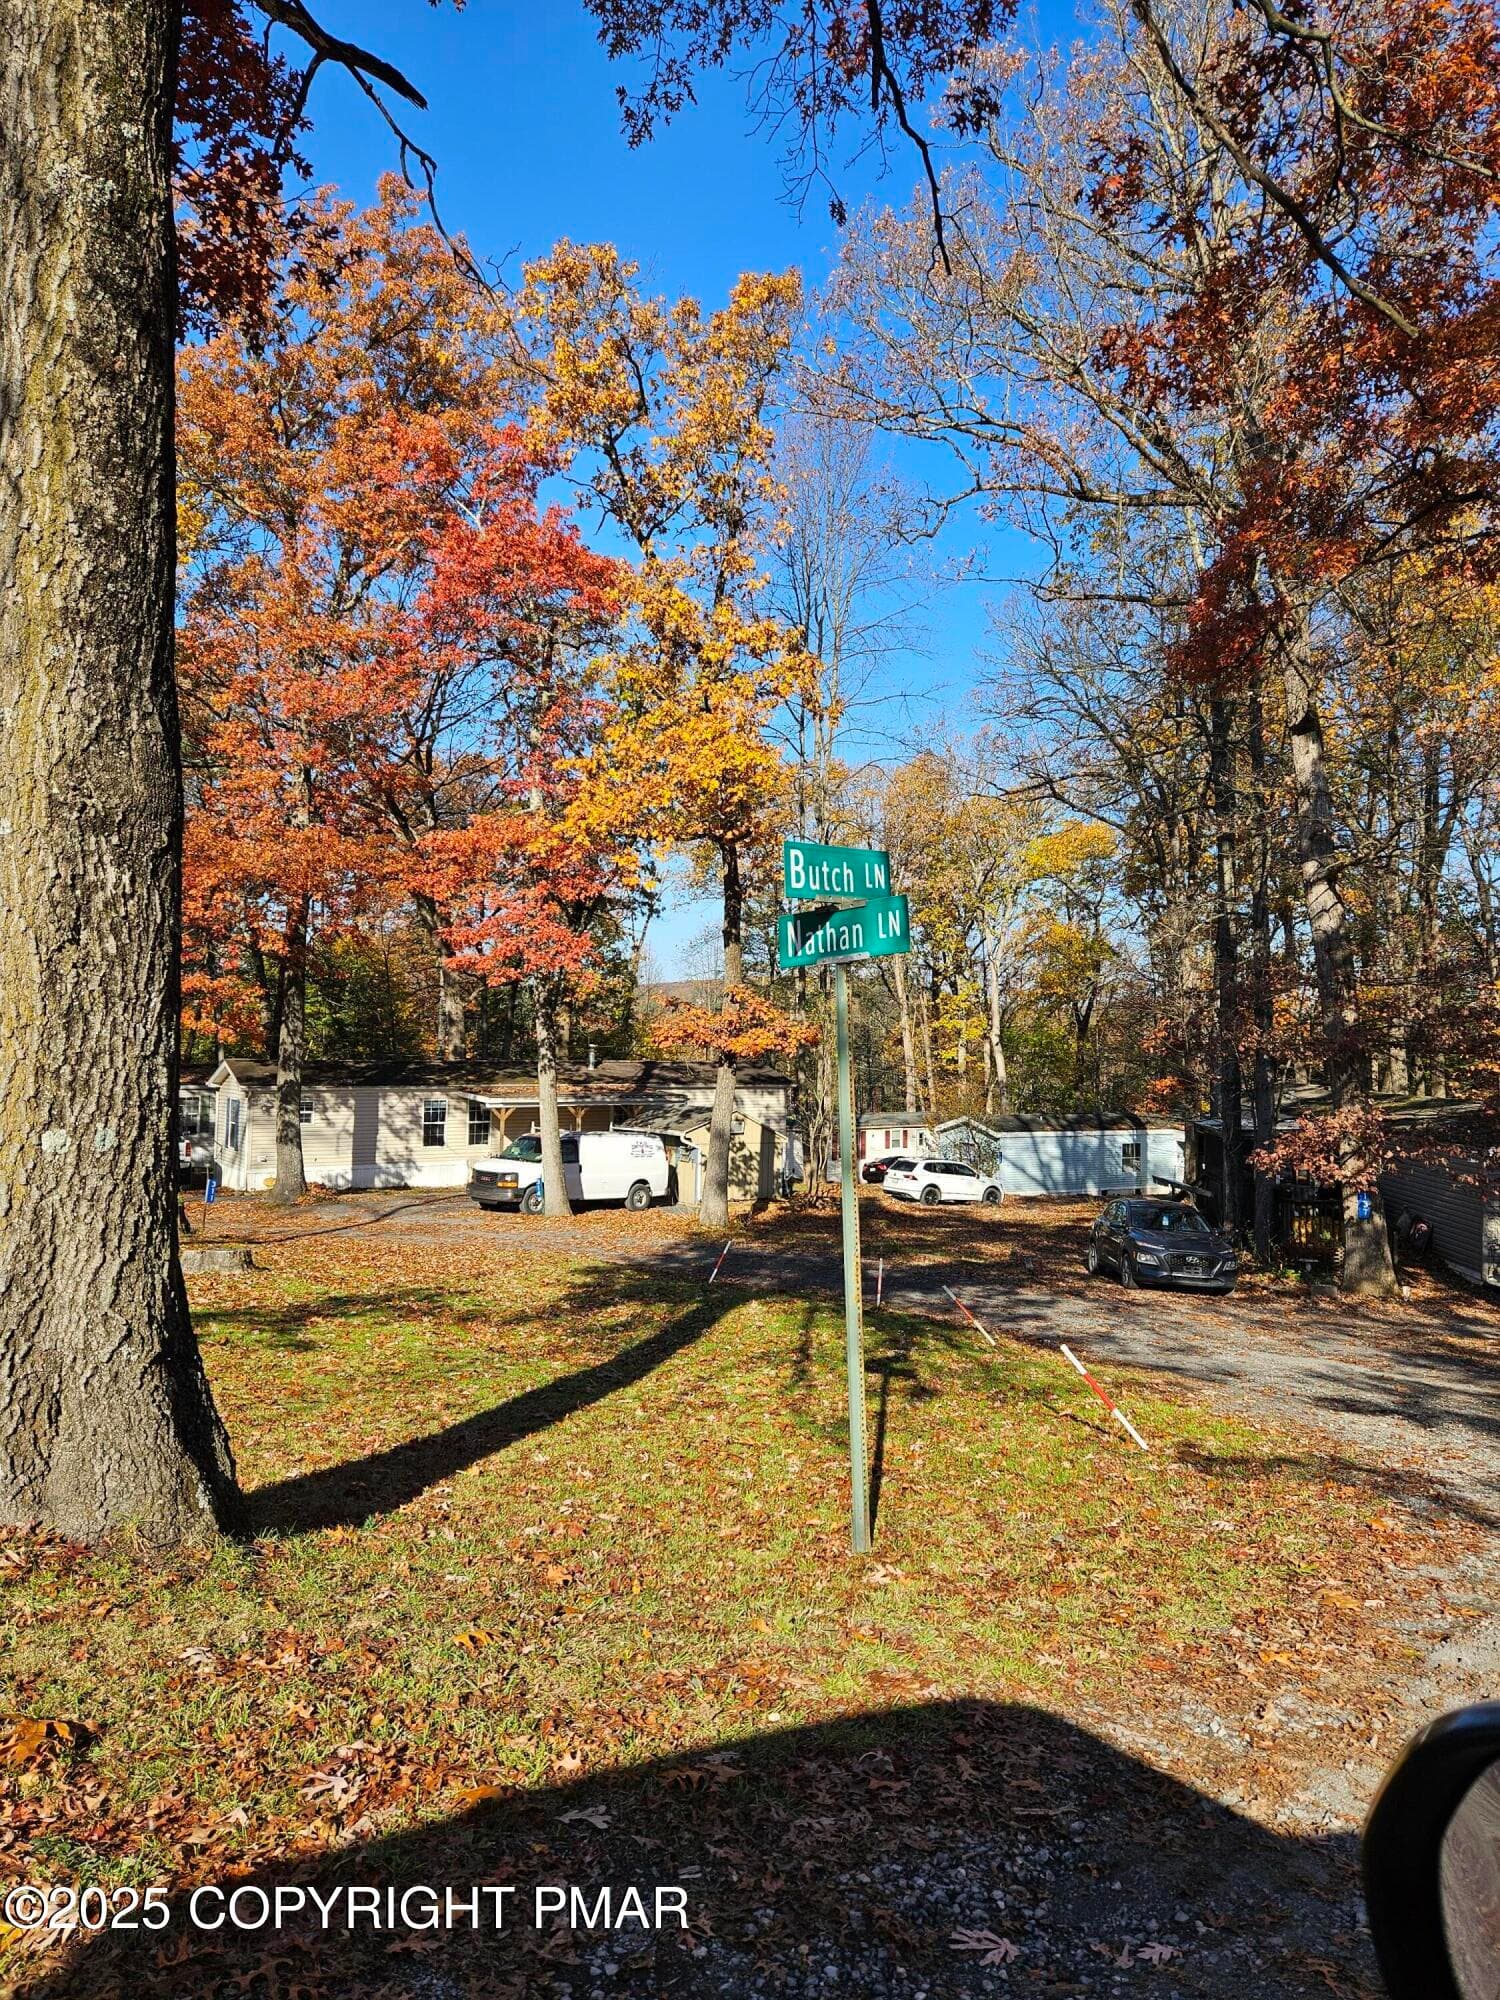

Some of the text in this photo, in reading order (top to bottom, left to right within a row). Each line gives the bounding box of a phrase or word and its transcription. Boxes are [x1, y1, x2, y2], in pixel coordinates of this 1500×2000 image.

[790, 848, 886, 893] Butch LN
[787, 910, 901, 958] Nathan LN
